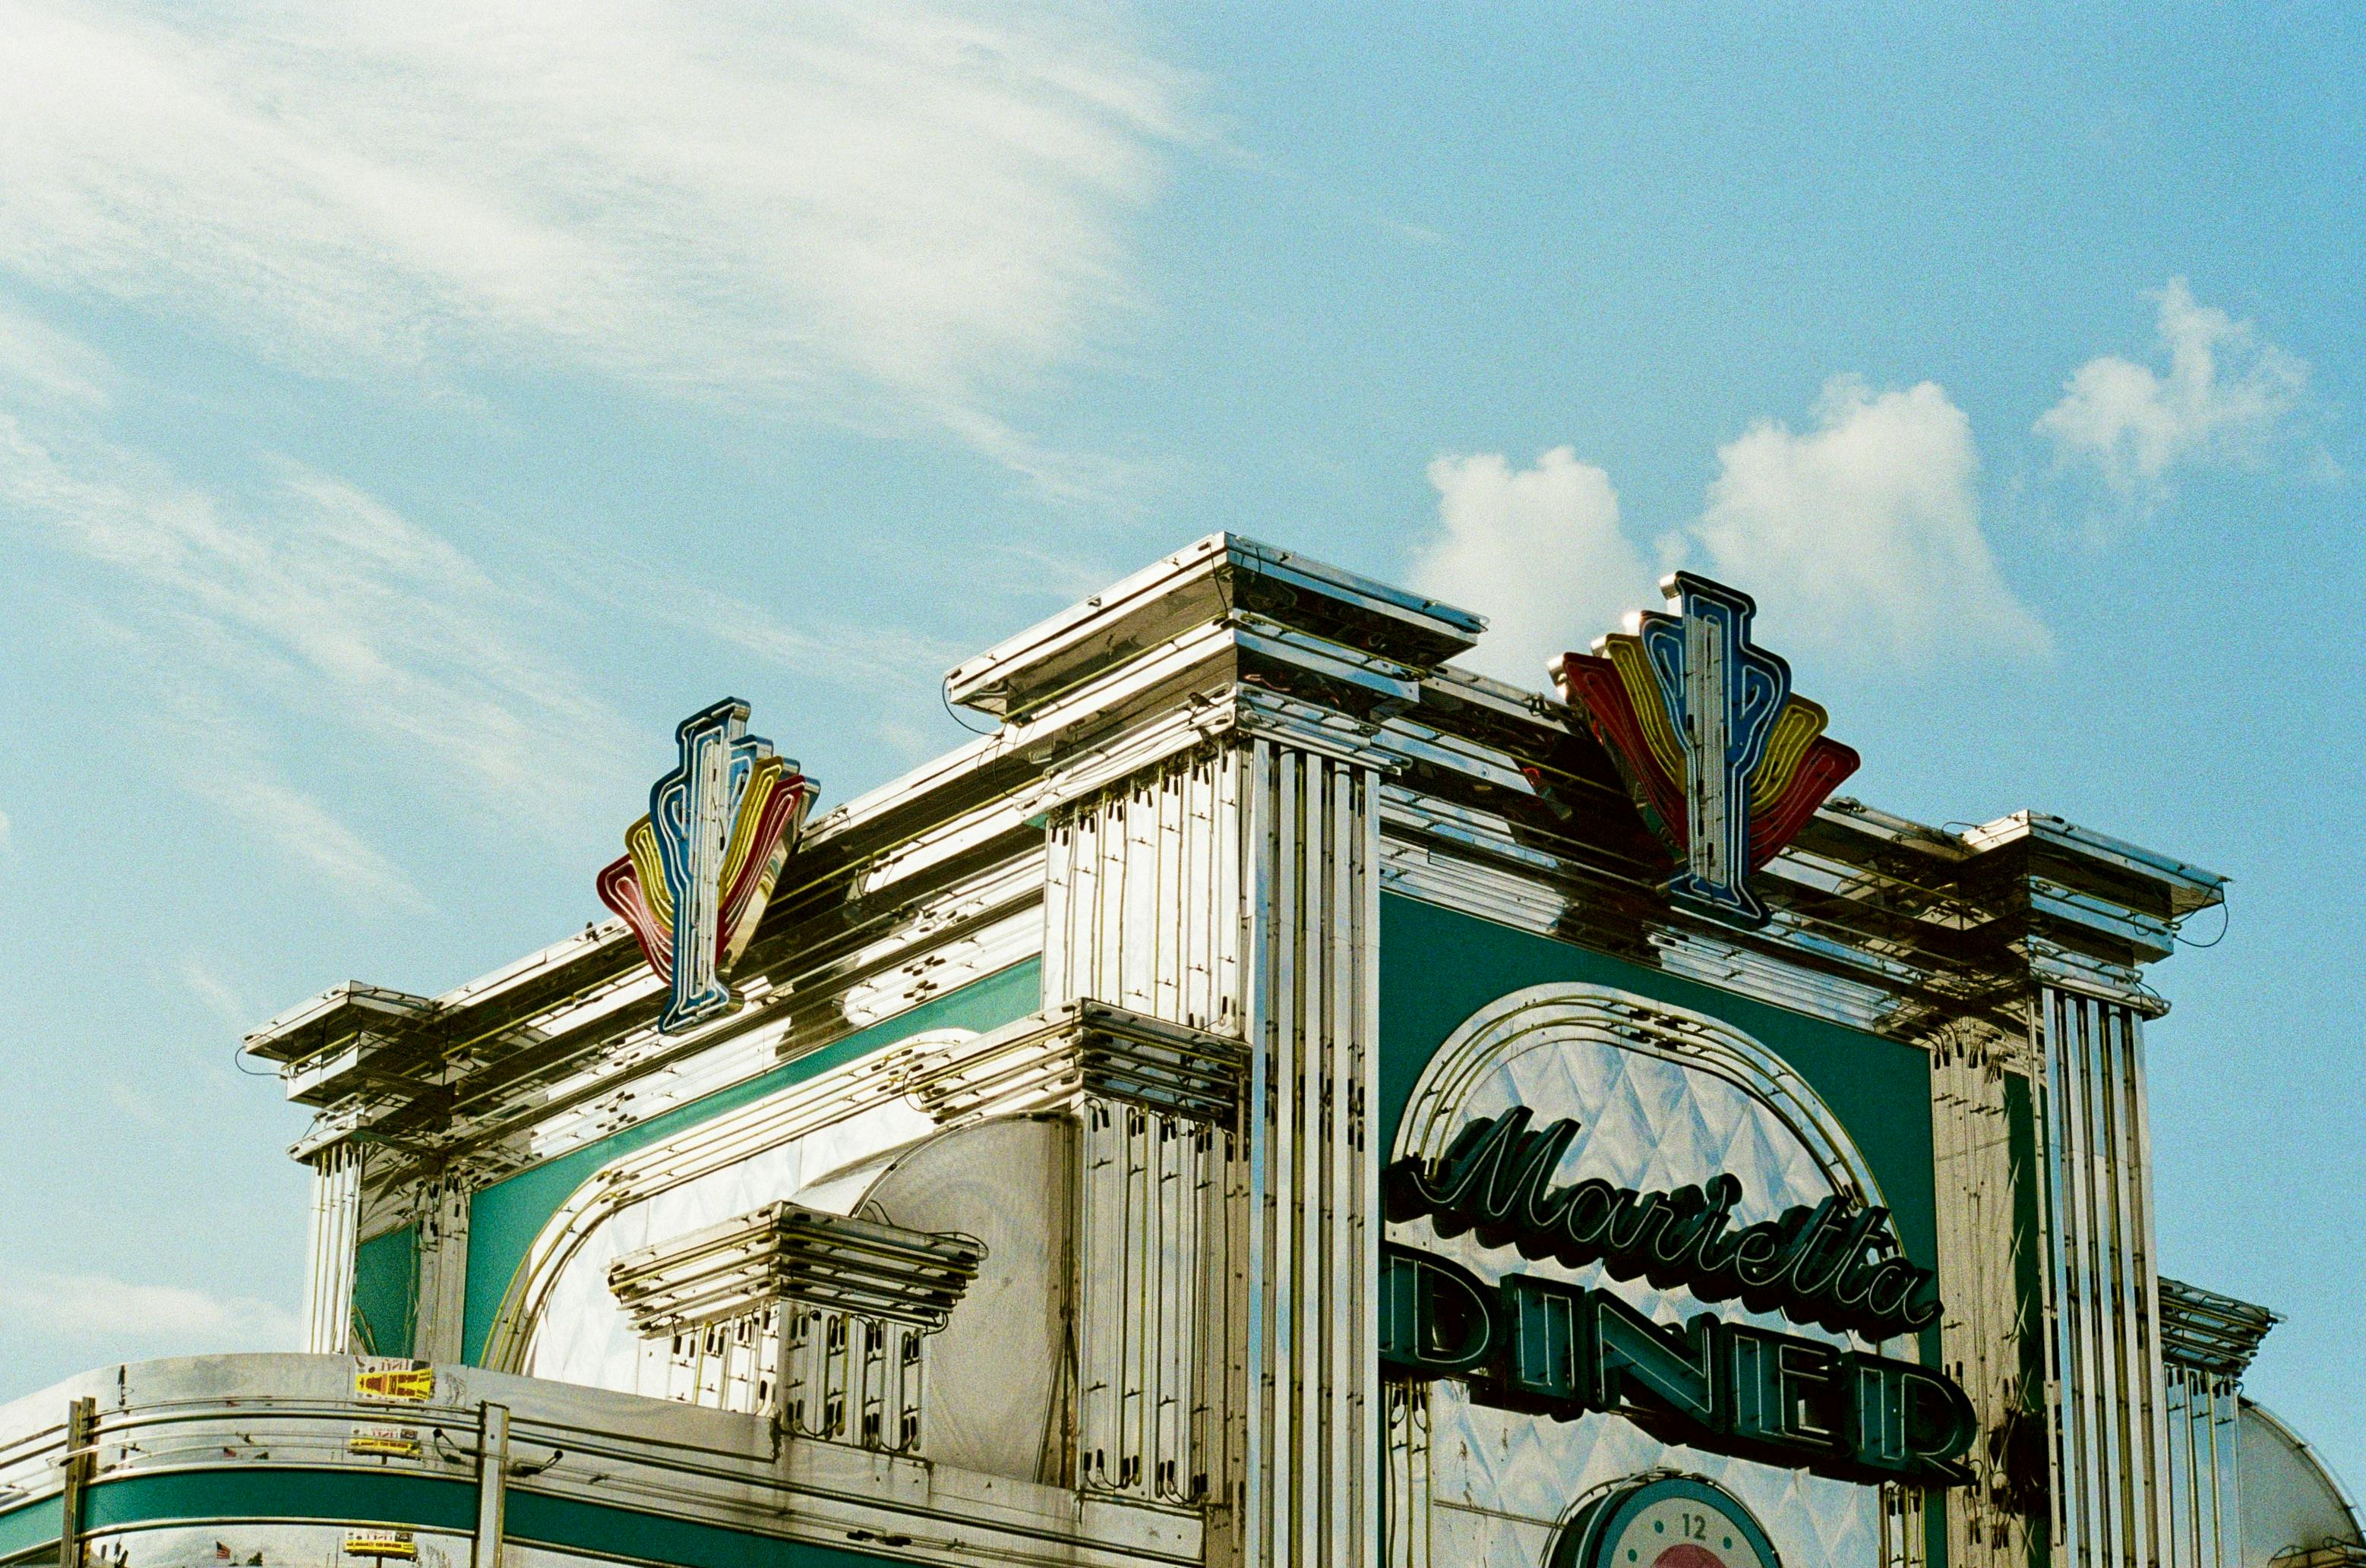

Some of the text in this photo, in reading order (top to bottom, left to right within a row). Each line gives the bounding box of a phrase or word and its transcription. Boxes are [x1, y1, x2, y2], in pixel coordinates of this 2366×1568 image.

[1387, 1106, 1944, 1336] Marietta
[1379, 1242, 1976, 1486] DINER
[1682, 1513, 1707, 1541] 12
